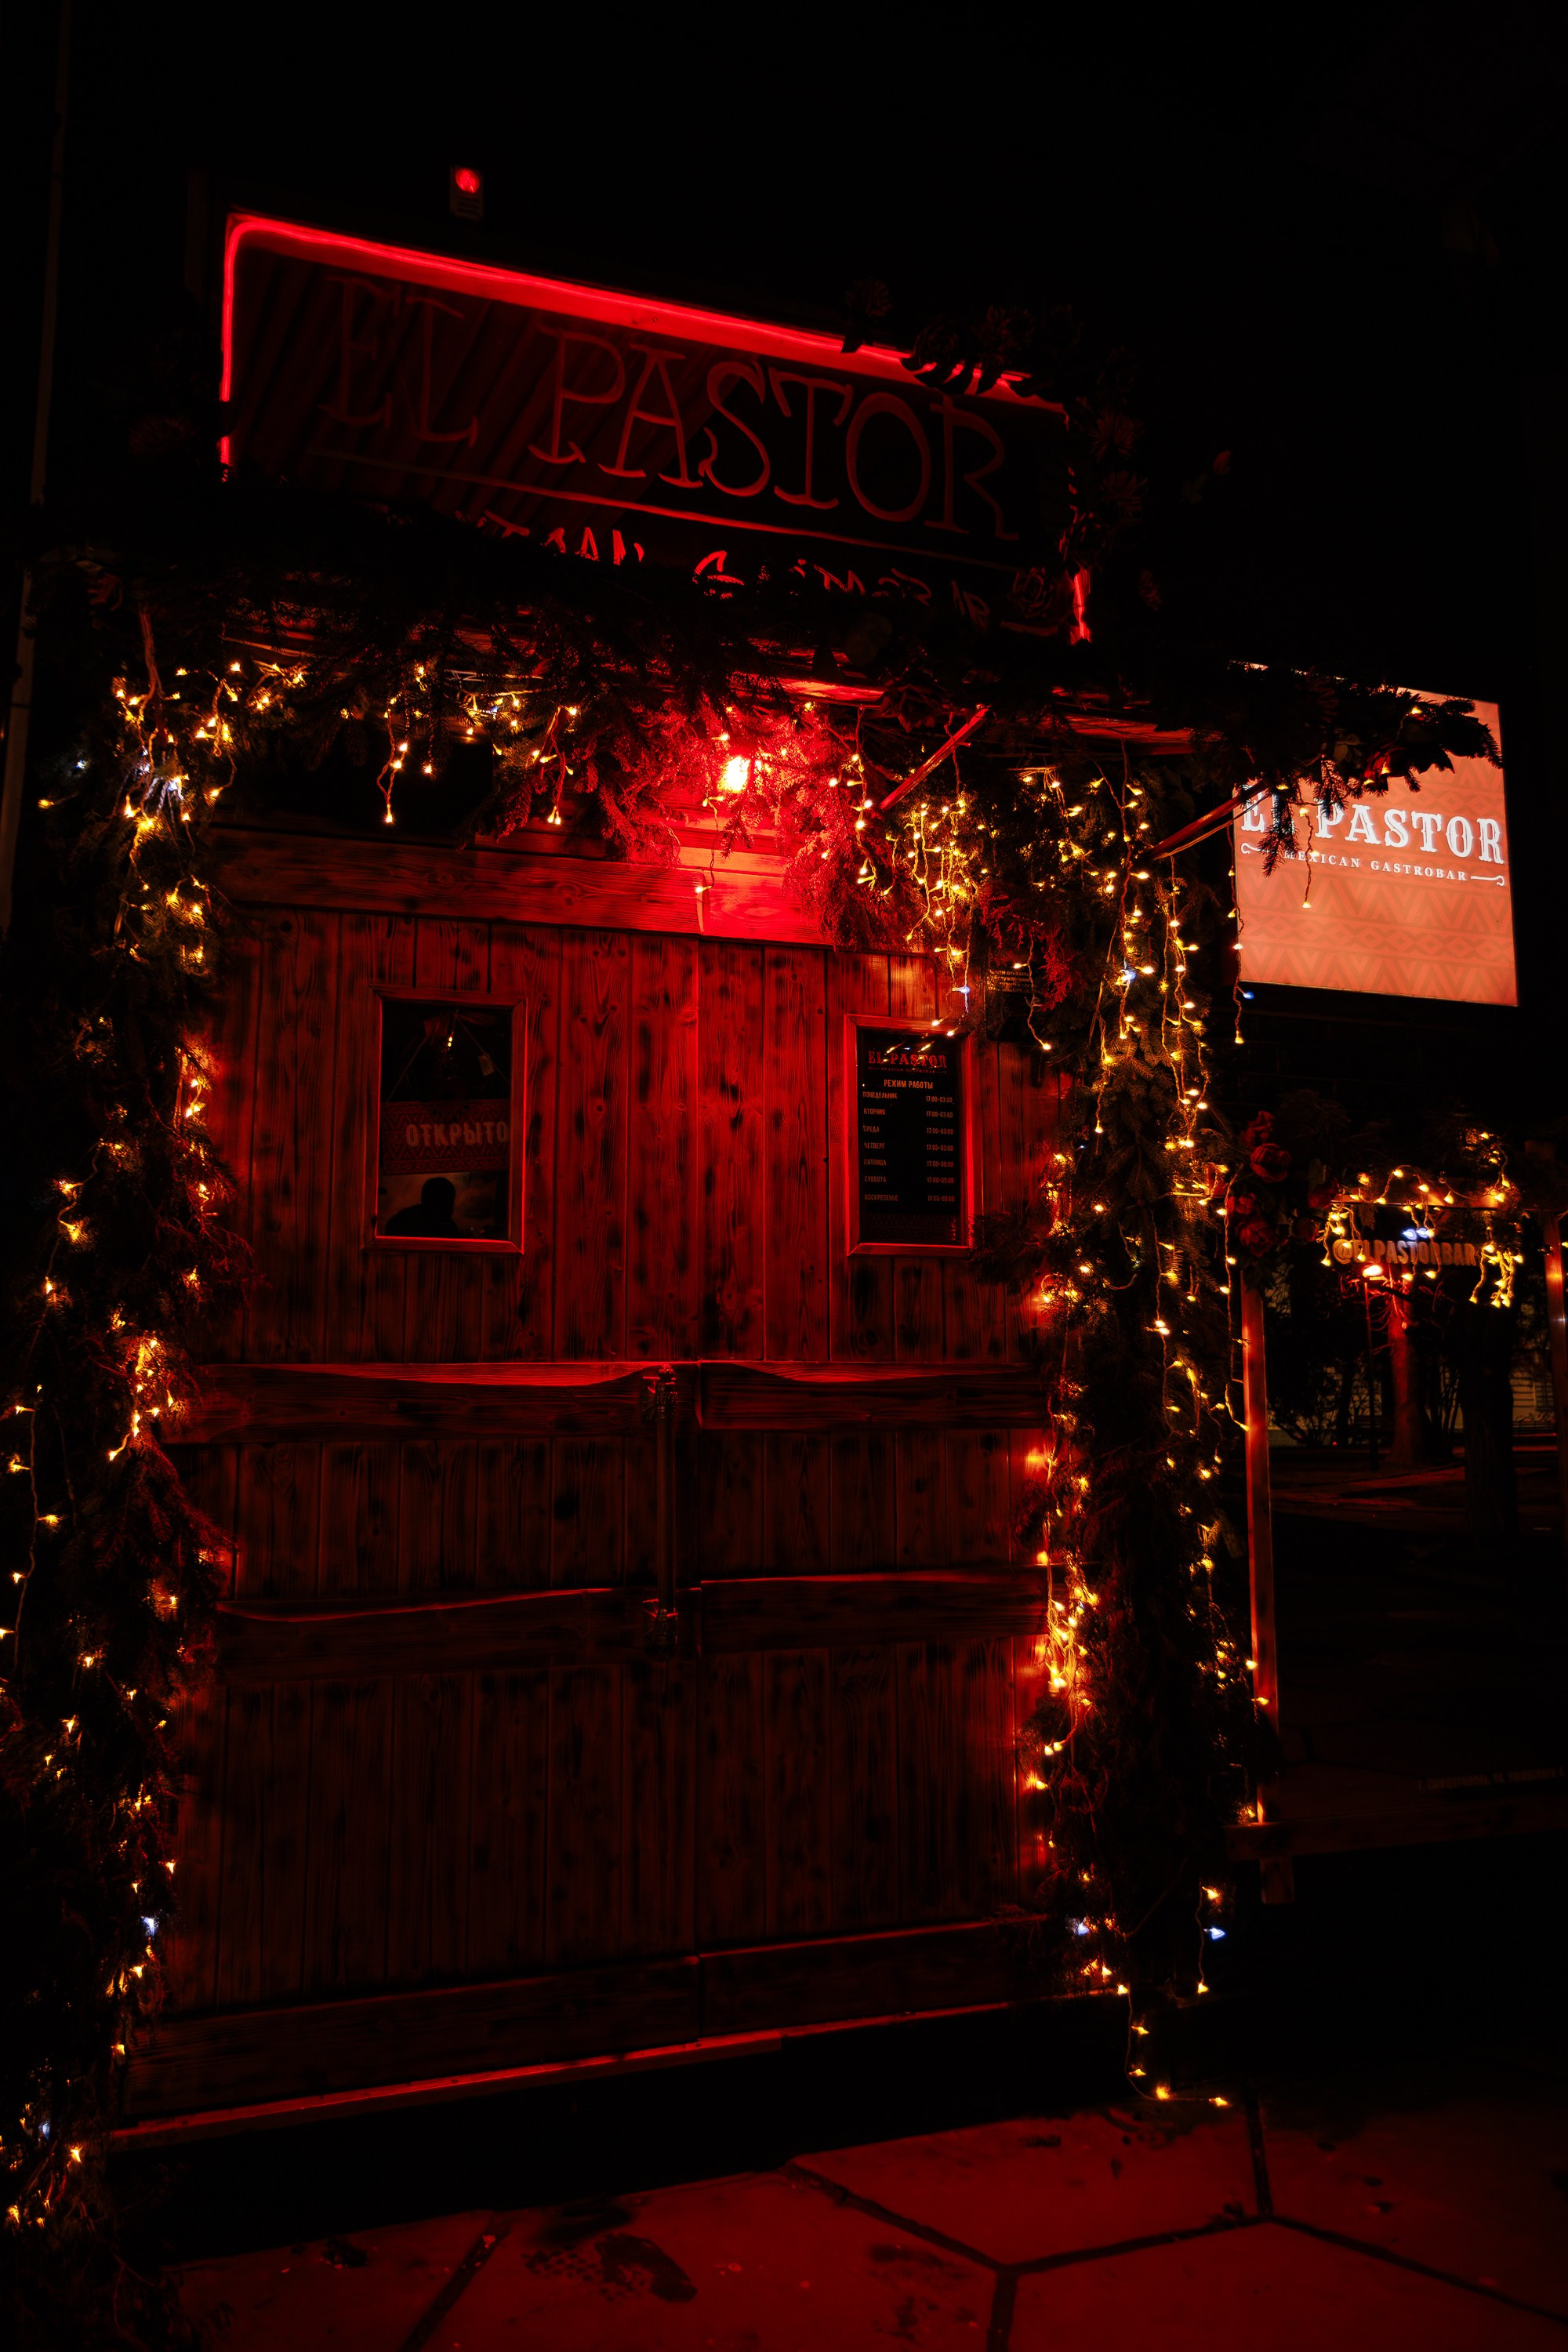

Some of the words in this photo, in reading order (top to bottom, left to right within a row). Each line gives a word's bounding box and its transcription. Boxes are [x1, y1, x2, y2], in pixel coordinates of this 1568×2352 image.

[317, 274, 480, 448] EL
[527, 323, 1019, 541] PASTOR
[1314, 797, 1504, 864] PASTOR
[1370, 860, 1467, 881] GASTROBAR
[868, 1051, 884, 1064] EL
[890, 1053, 947, 1068] PASTOR
[862, 1091, 898, 1100] ПОНЕДЕЛЬНИК
[884, 1080, 907, 1088] РЕЖИМ
[908, 1080, 934, 1090] РАБОТЫ
[405, 1121, 509, 1147] ОТКРЫТО
[1333, 1239, 1477, 1267] @ELPASTORBAR
